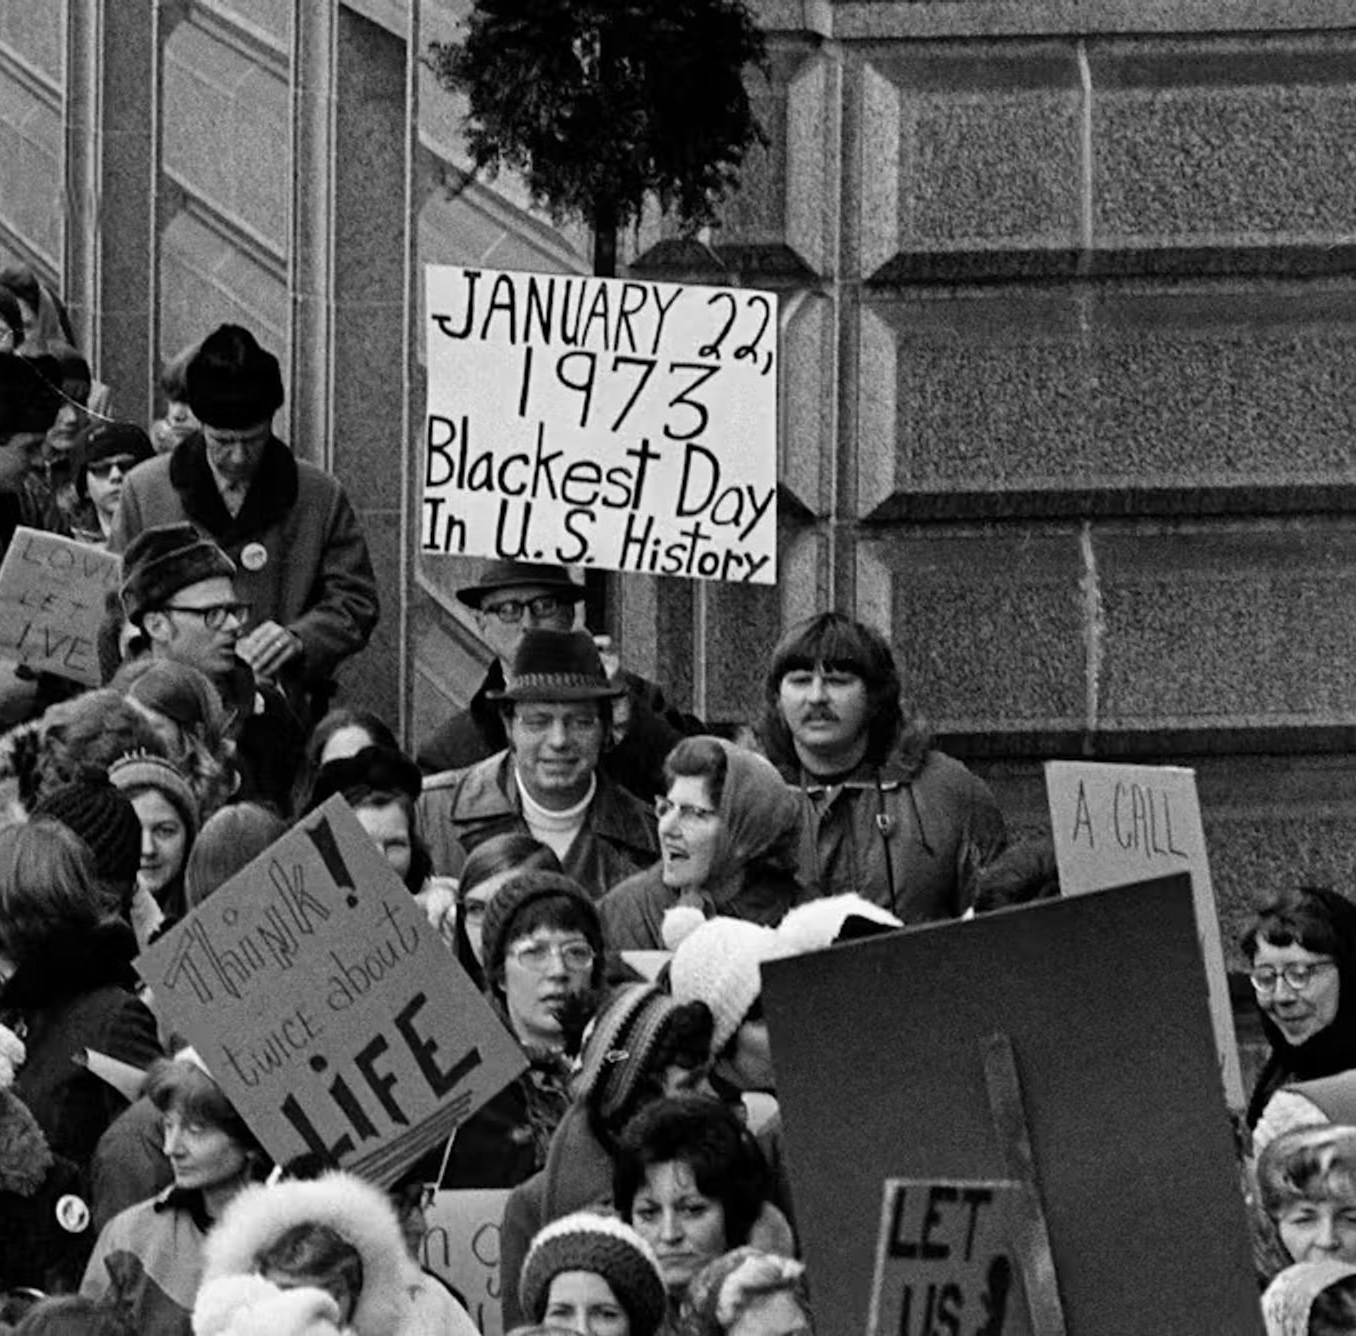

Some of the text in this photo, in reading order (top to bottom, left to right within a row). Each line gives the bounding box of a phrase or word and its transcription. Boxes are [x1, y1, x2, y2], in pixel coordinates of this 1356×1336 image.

[431, 270, 775, 376] JANUARY 22,
[518, 346, 722, 441] 1973
[424, 413, 776, 542] Blackest Day
[421, 497, 467, 553] In
[618, 512, 771, 582] History
[1072, 778, 1191, 860] A CALL
[326, 900, 420, 1012] about
[888, 1186, 994, 1264] LET
